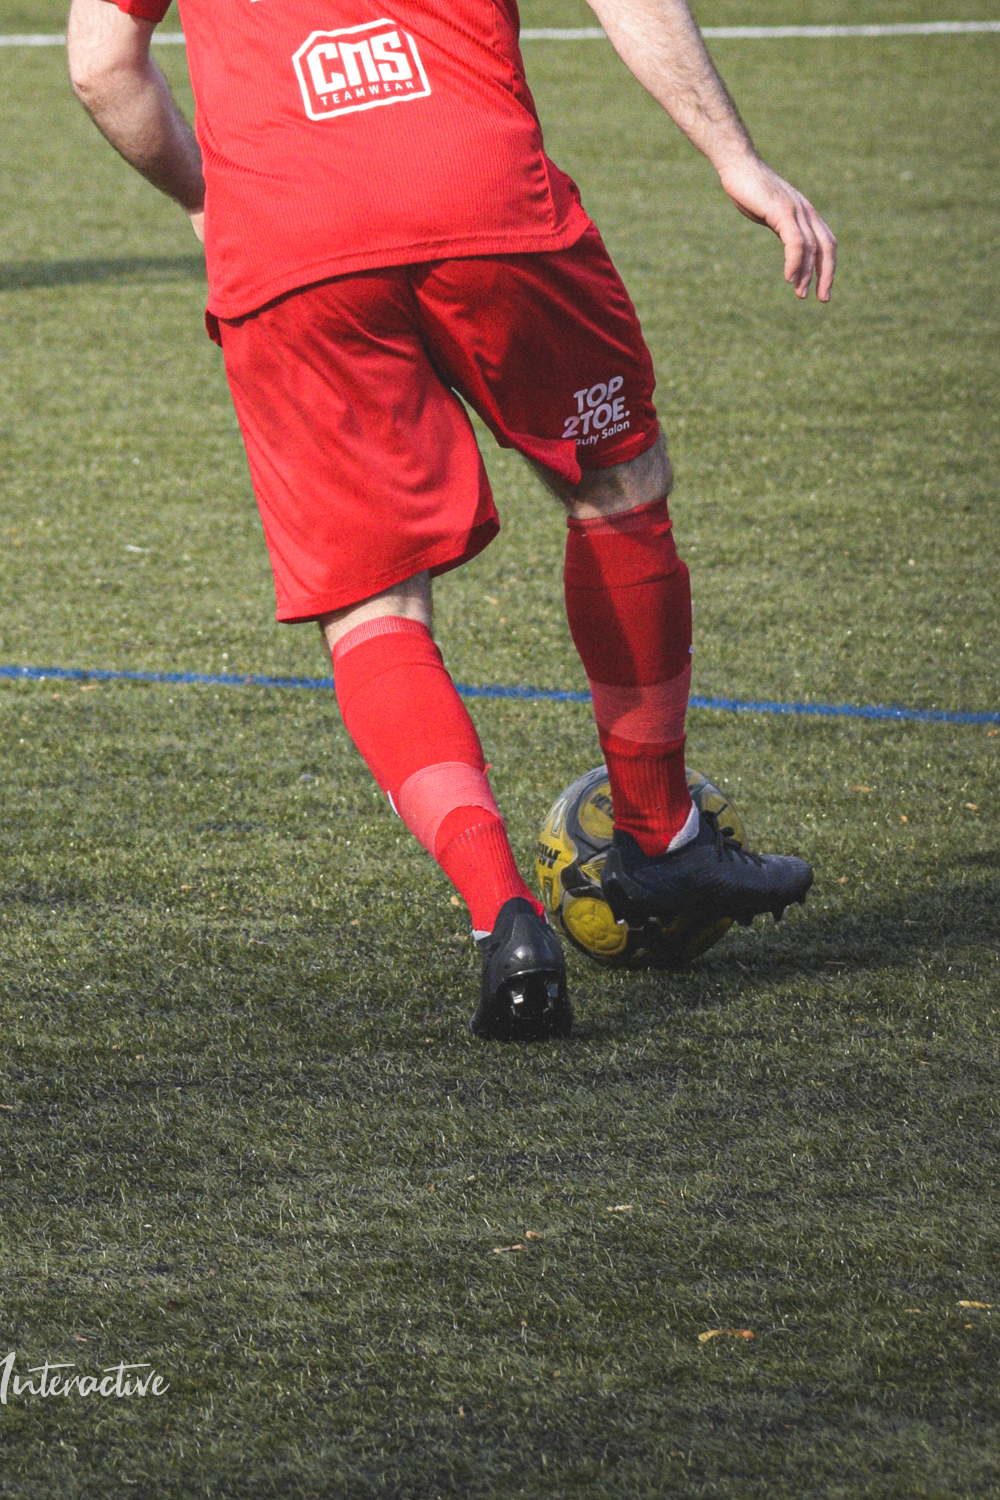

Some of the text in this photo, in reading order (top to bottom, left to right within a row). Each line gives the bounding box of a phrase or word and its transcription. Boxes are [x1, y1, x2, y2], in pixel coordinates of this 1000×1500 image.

[320, 81, 414, 106] TEAMWEAR
[573, 375, 624, 413] TOP
[601, 420, 630, 439] Salon
